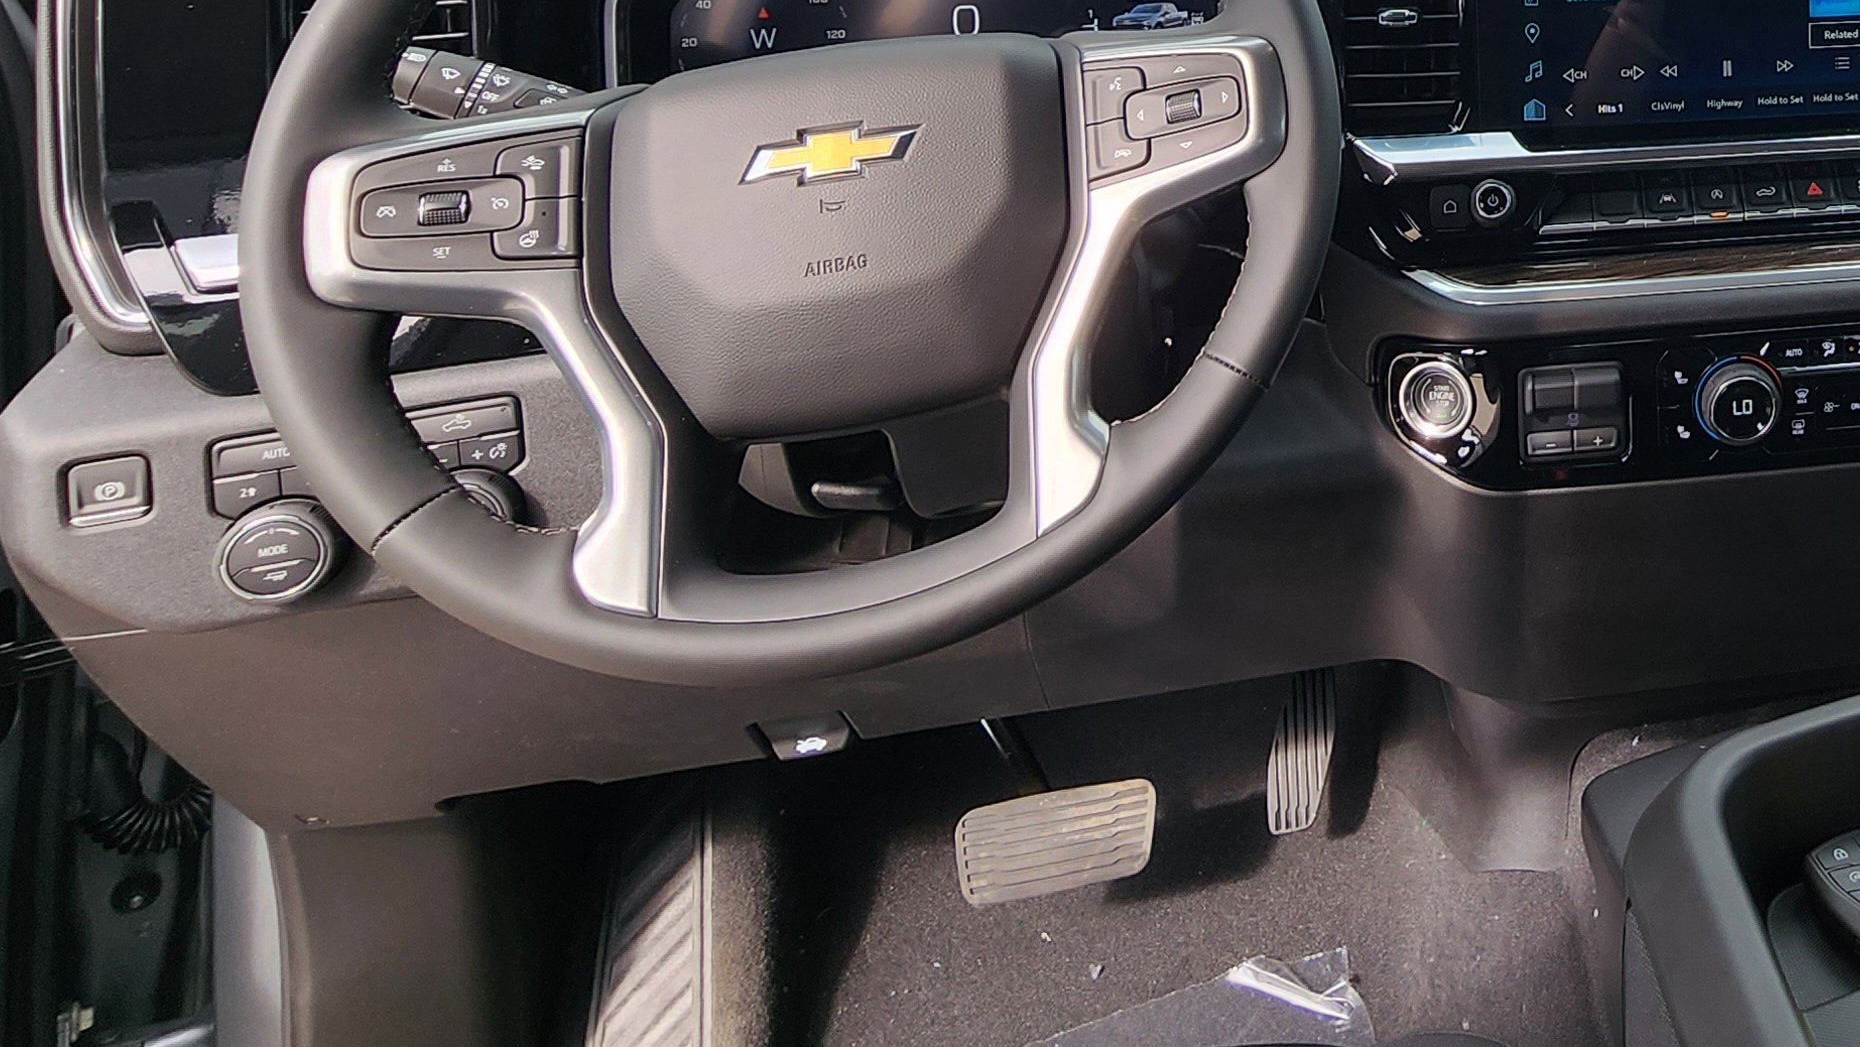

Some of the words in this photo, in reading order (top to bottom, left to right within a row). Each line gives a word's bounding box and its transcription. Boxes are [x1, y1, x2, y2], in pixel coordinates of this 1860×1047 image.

[695, 0, 711, 9] 40
[1087, 9, 1093, 18] 1
[952, 4, 979, 35] 0
[750, 28, 777, 49] W
[826, 29, 846, 40] 120
[1824, 29, 1859, 40] Related
[681, 37, 698, 48] 20
[481, 91, 499, 103] OFF
[1757, 96, 1777, 105] Hold
[1779, 96, 1788, 104] to
[1790, 95, 1804, 104] Set
[1813, 93, 1832, 103] Hold
[1834, 93, 1844, 102] to
[1844, 93, 1859, 101] Set
[1598, 104, 1616, 114] Hits
[1618, 103, 1623, 113] 1
[1706, 99, 1743, 110] Highway
[437, 163, 456, 172] RES
[433, 247, 451, 257] SET
[803, 253, 868, 278] AIRBAG
[1785, 348, 1803, 357] AUTO
[1429, 391, 1455, 401] ENGINE
[1732, 399, 1753, 416] LO
[258, 544, 288, 557] MODE
